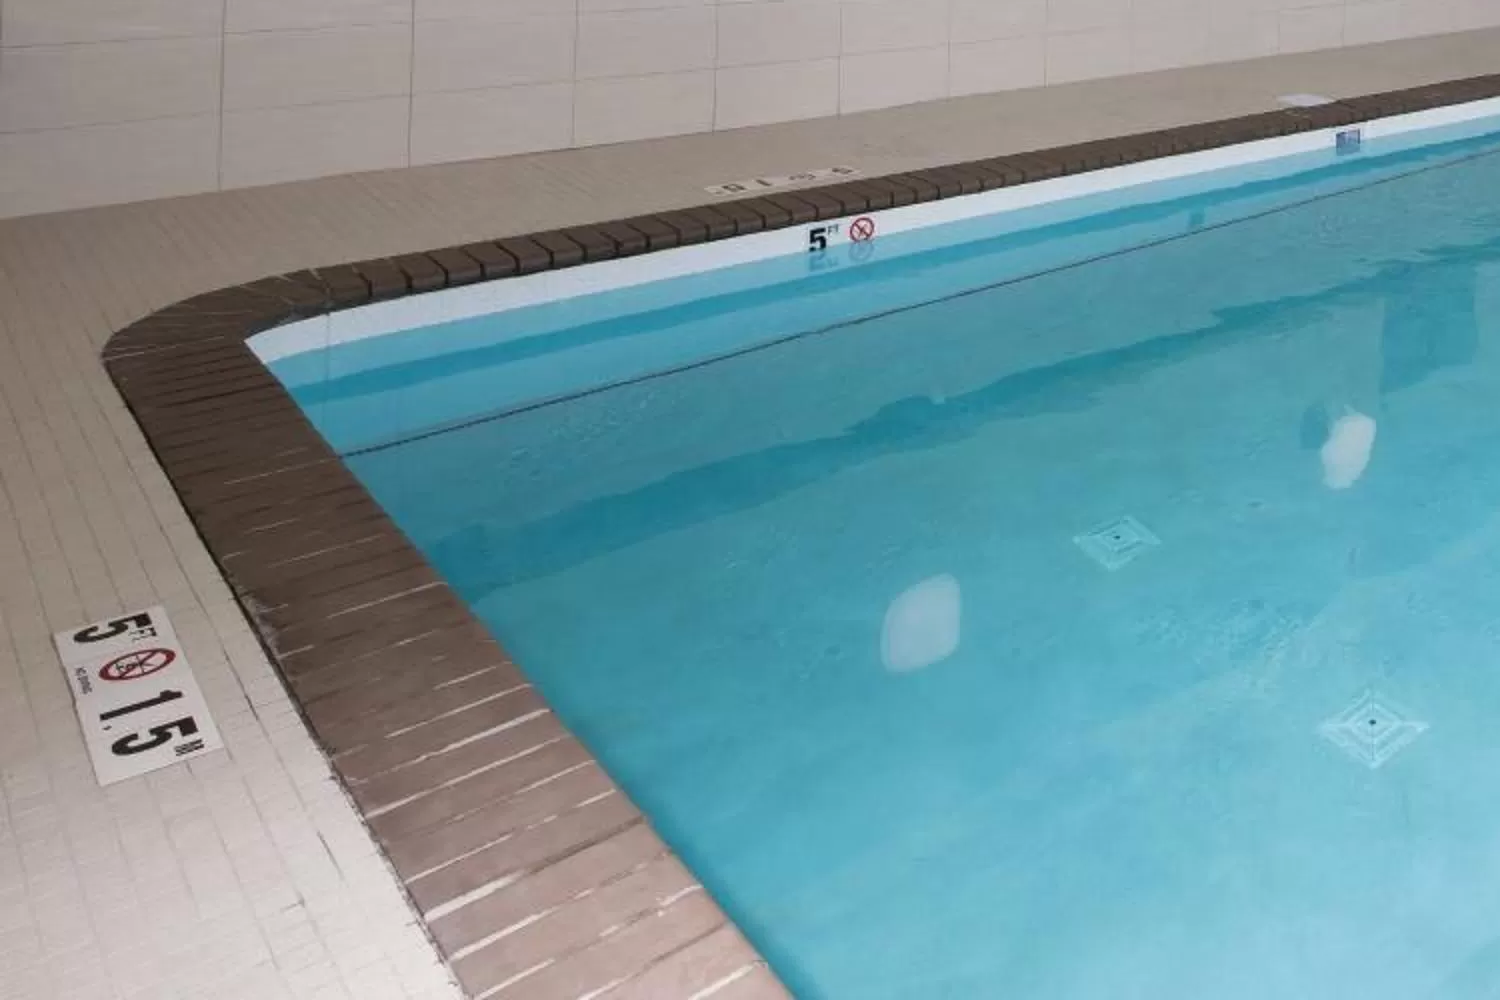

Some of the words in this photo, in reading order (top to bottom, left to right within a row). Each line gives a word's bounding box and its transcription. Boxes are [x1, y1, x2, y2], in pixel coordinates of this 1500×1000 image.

[809, 227, 827, 252] 5
[73, 612, 153, 643] 5
[99, 690, 199, 757] 1.5
